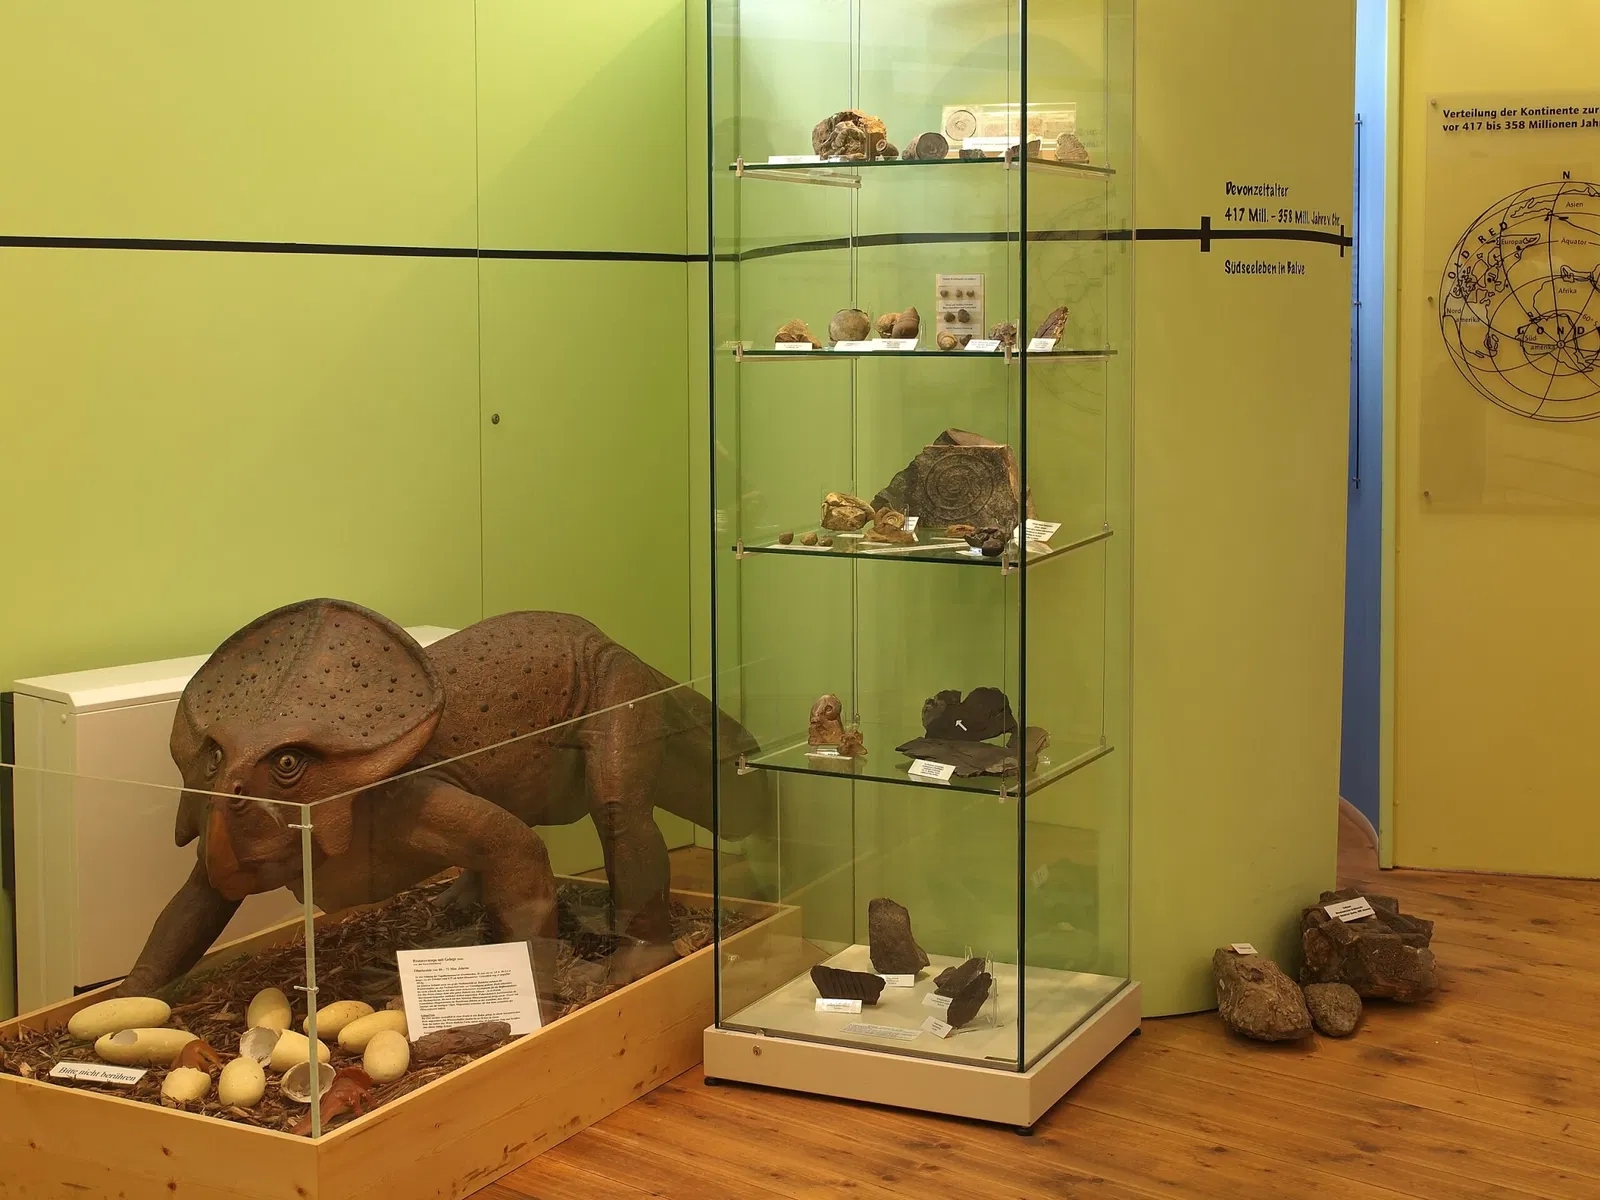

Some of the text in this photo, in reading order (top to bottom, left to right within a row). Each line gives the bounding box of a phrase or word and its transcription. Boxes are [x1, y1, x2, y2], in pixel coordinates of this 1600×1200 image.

[1443, 106, 1599, 119] Verteilung der Kontinente zur
[1462, 121, 1482, 131] 417
[1486, 121, 1501, 130] bis
[1505, 120, 1525, 130] 358
[1529, 119, 1578, 129] Millionen
[1580, 118, 1600, 128] Jah
[1562, 171, 1570, 179] N
[1225, 181, 1289, 197] Devonzeitalter
[1225, 207, 1245, 221] 417
[1248, 208, 1268, 223] Mill.
[1278, 209, 1293, 223] 358
[1295, 210, 1310, 225] Mill.
[1225, 259, 1305, 274] Südseeleben in Balve
[58, 1066, 137, 1082] Bitte nicht berühren
